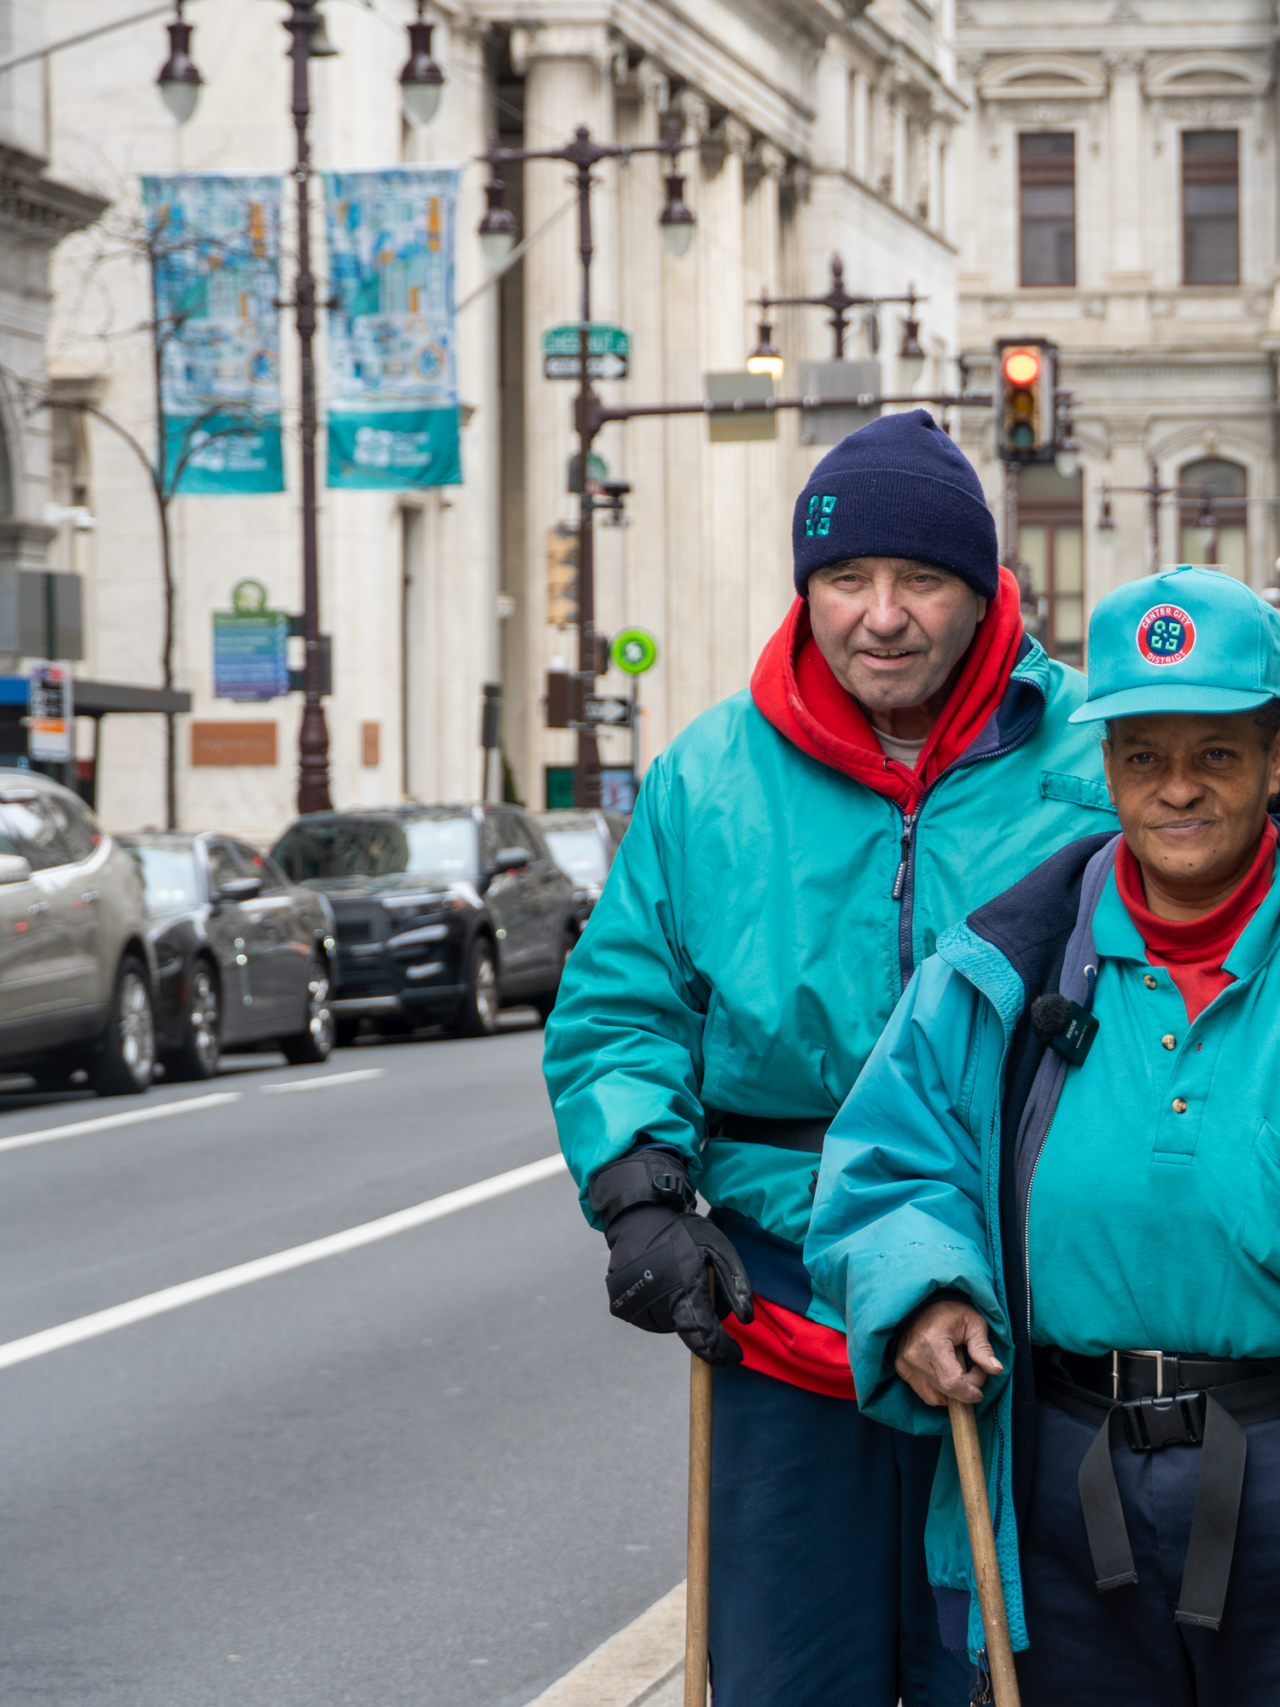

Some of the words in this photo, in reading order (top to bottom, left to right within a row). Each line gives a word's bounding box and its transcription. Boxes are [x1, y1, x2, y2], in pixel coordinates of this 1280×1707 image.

[1141, 607, 1171, 629] CENTER
[1173, 609, 1191, 625] CITY
[1147, 649, 1186, 664] DISTRICT
